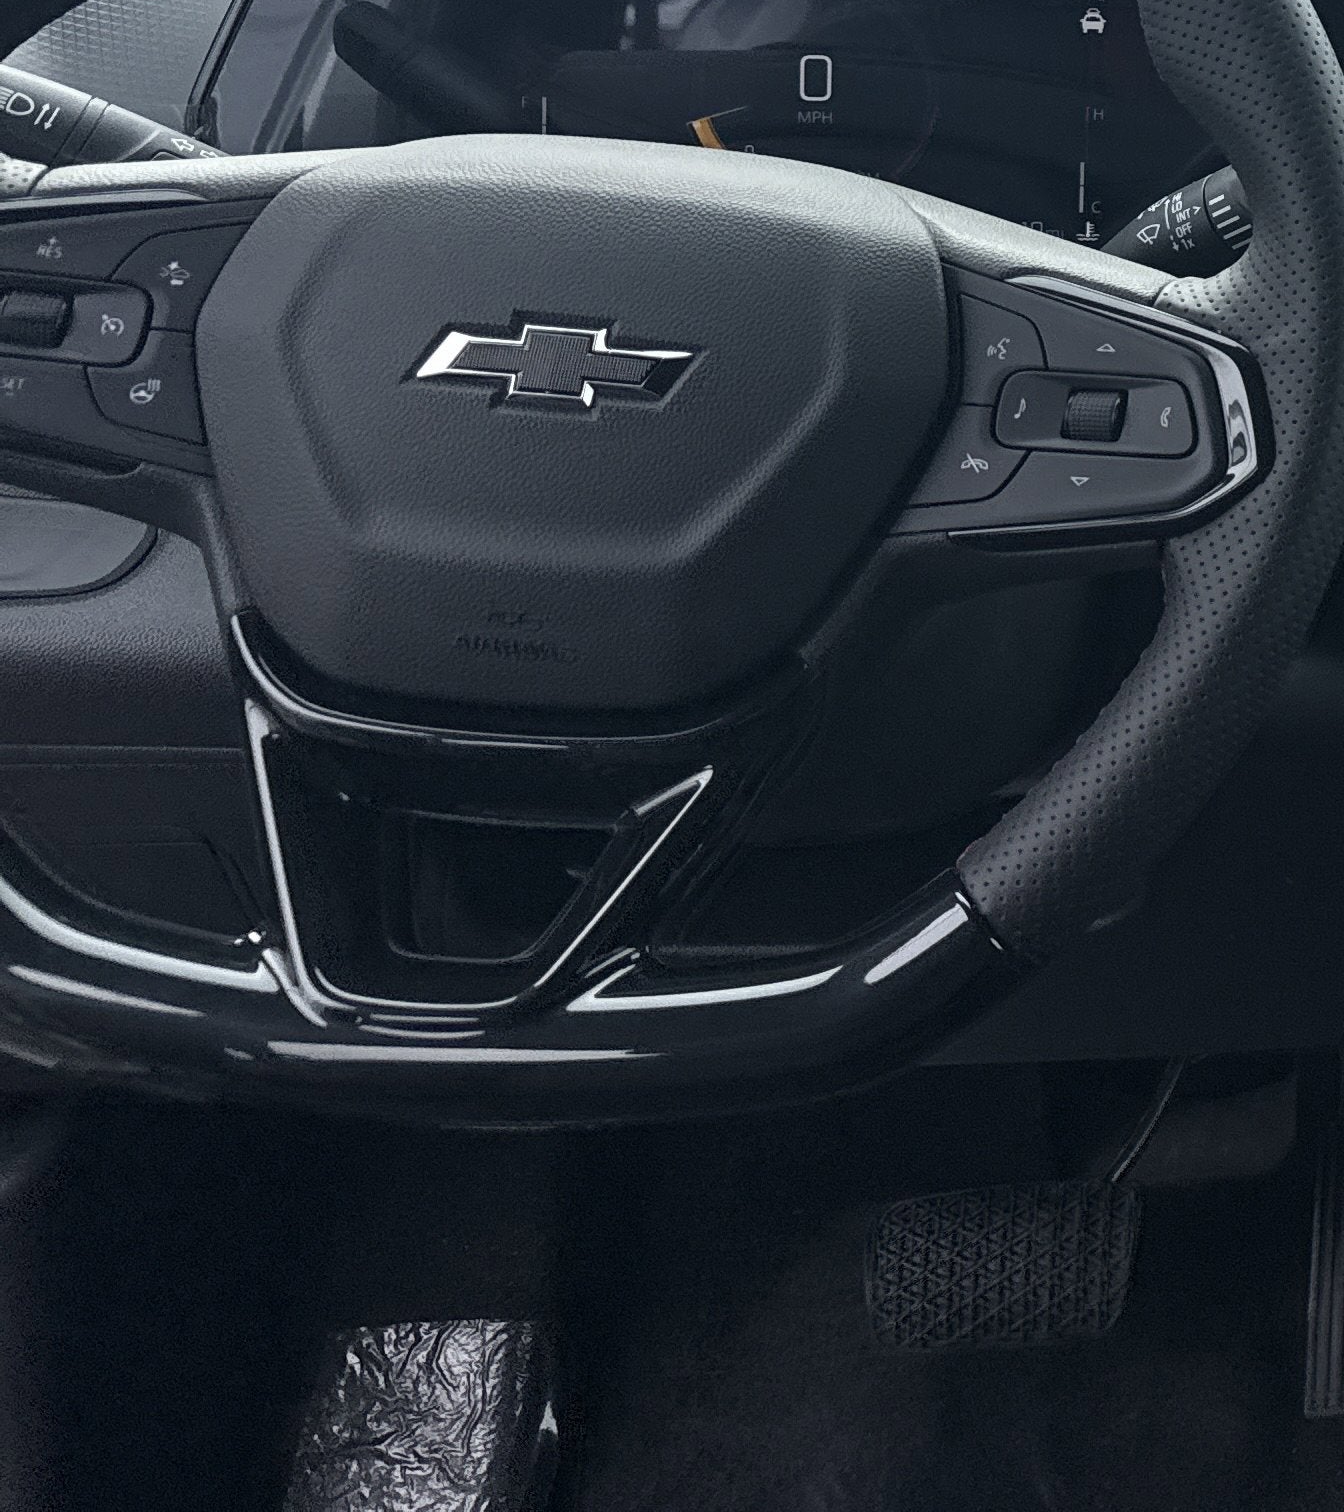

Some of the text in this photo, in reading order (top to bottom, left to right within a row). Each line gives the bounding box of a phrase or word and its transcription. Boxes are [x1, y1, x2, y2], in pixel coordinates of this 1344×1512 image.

[799, 54, 833, 102] 0
[798, 111, 834, 125] MPH
[1093, 108, 1104, 121] H
[1091, 201, 1102, 214] C
[1171, 201, 1183, 214] LO
[1176, 209, 1190, 224] INT
[1175, 221, 1193, 238] OFF
